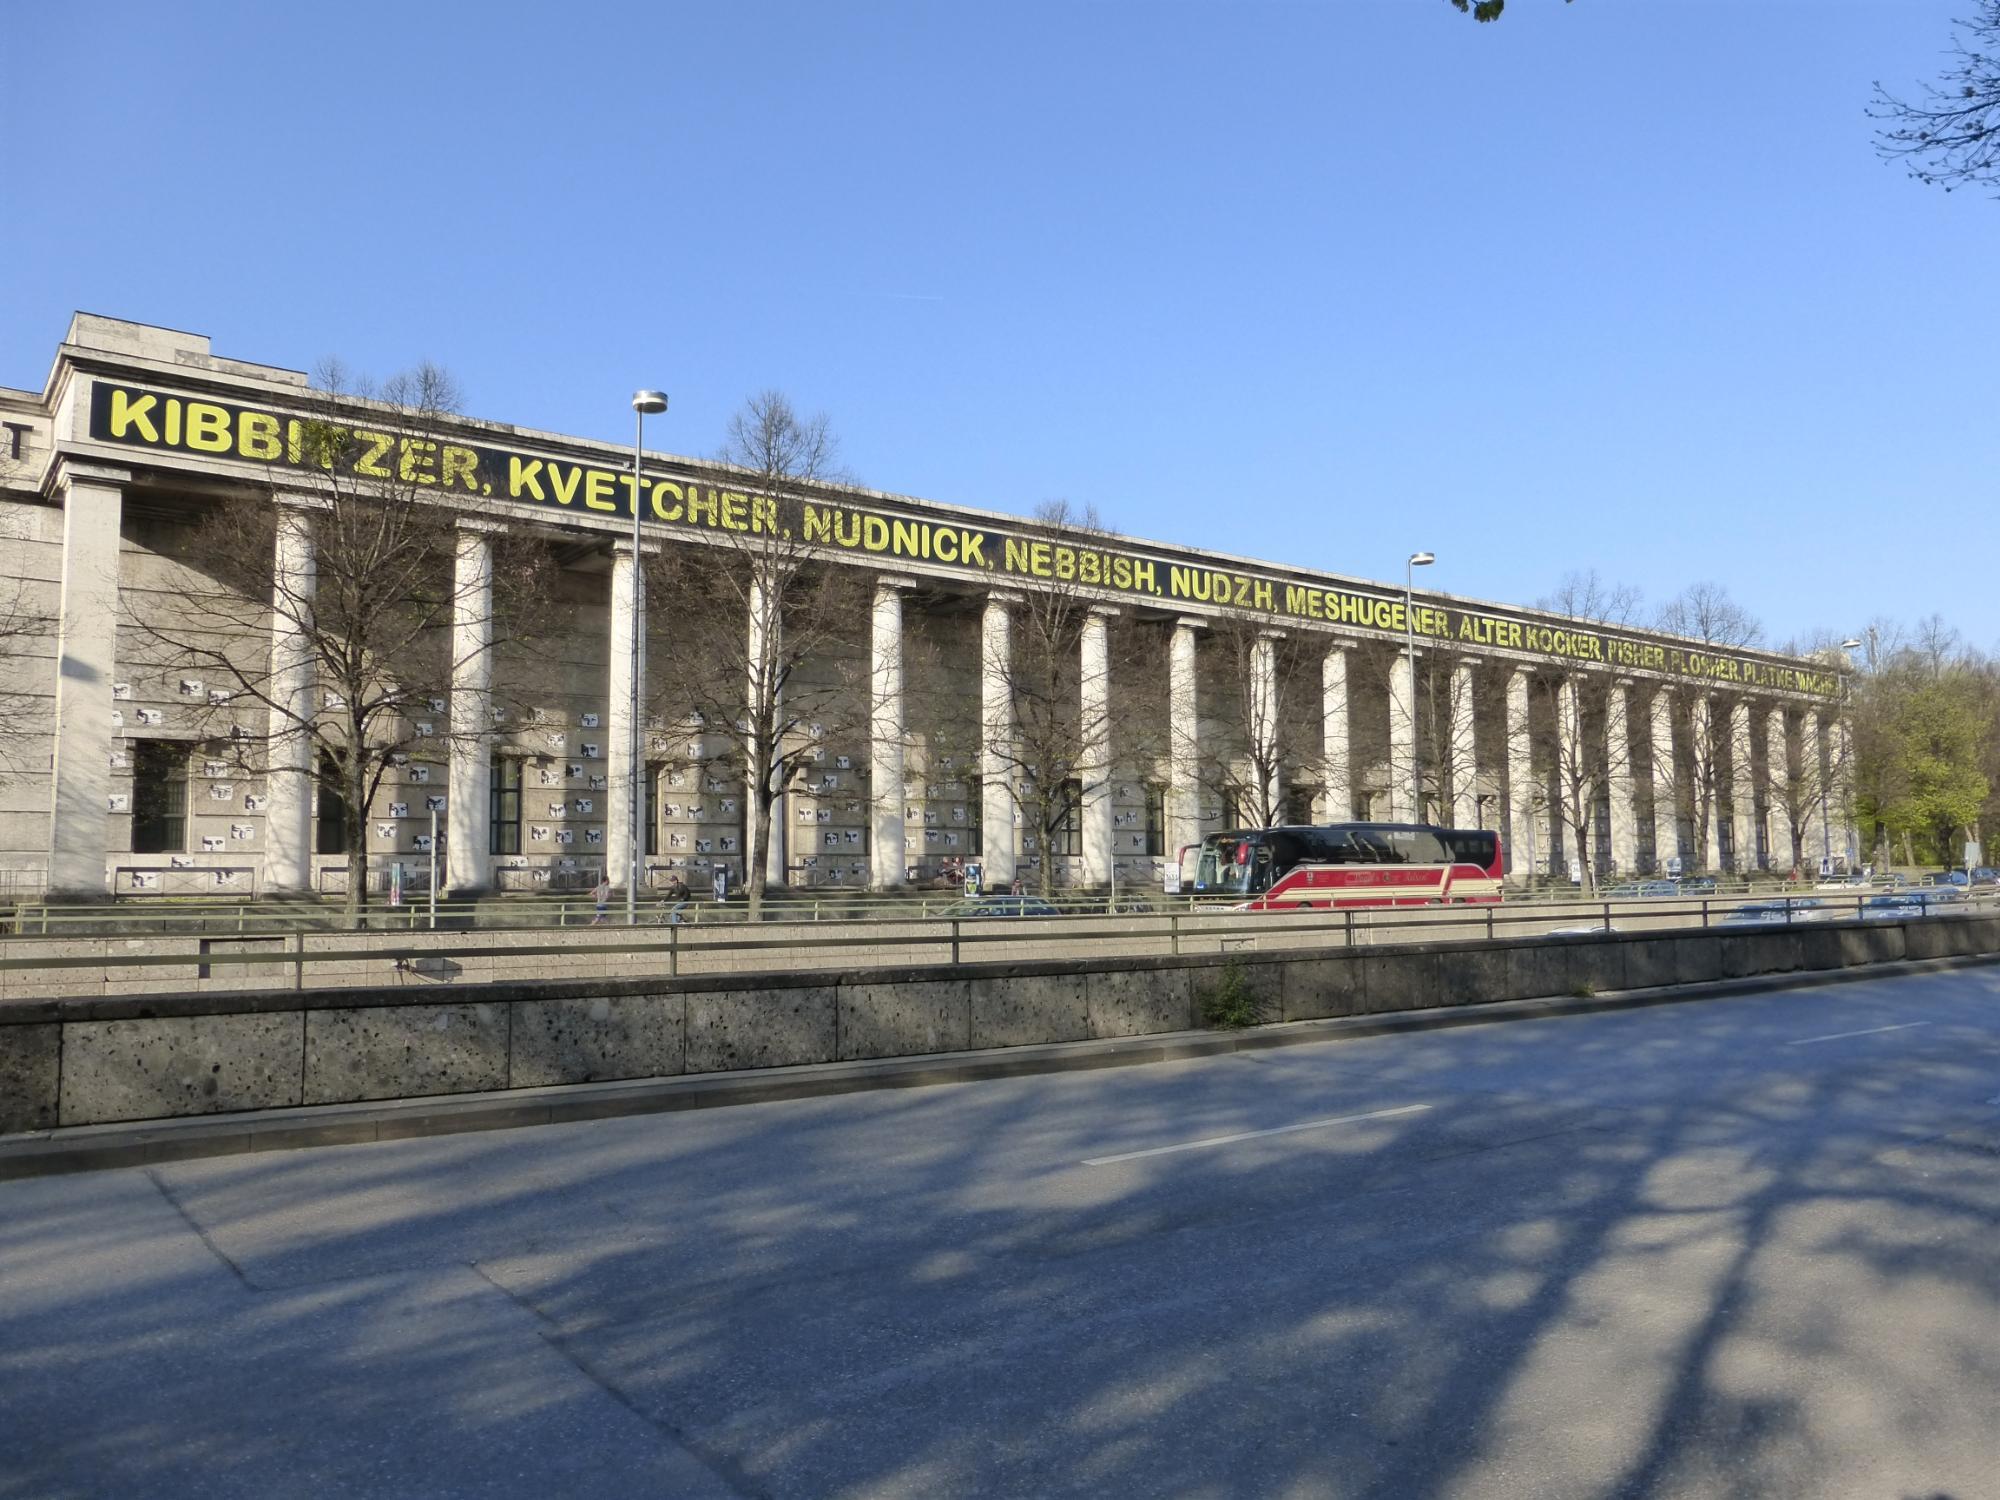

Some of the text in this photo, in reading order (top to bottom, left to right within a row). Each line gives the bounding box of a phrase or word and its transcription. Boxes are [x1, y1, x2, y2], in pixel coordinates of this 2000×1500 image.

[509, 456, 791, 541] KVETCHER,
[803, 505, 994, 570] NUDNICK,
[1005, 538, 1163, 596] NEBBISH,
[1170, 566, 1278, 613] NUDZH,
[1286, 585, 1454, 639] MESHUGENER,
[1459, 615, 1522, 648] ALTER
[1525, 625, 1604, 662] KOCKER,
